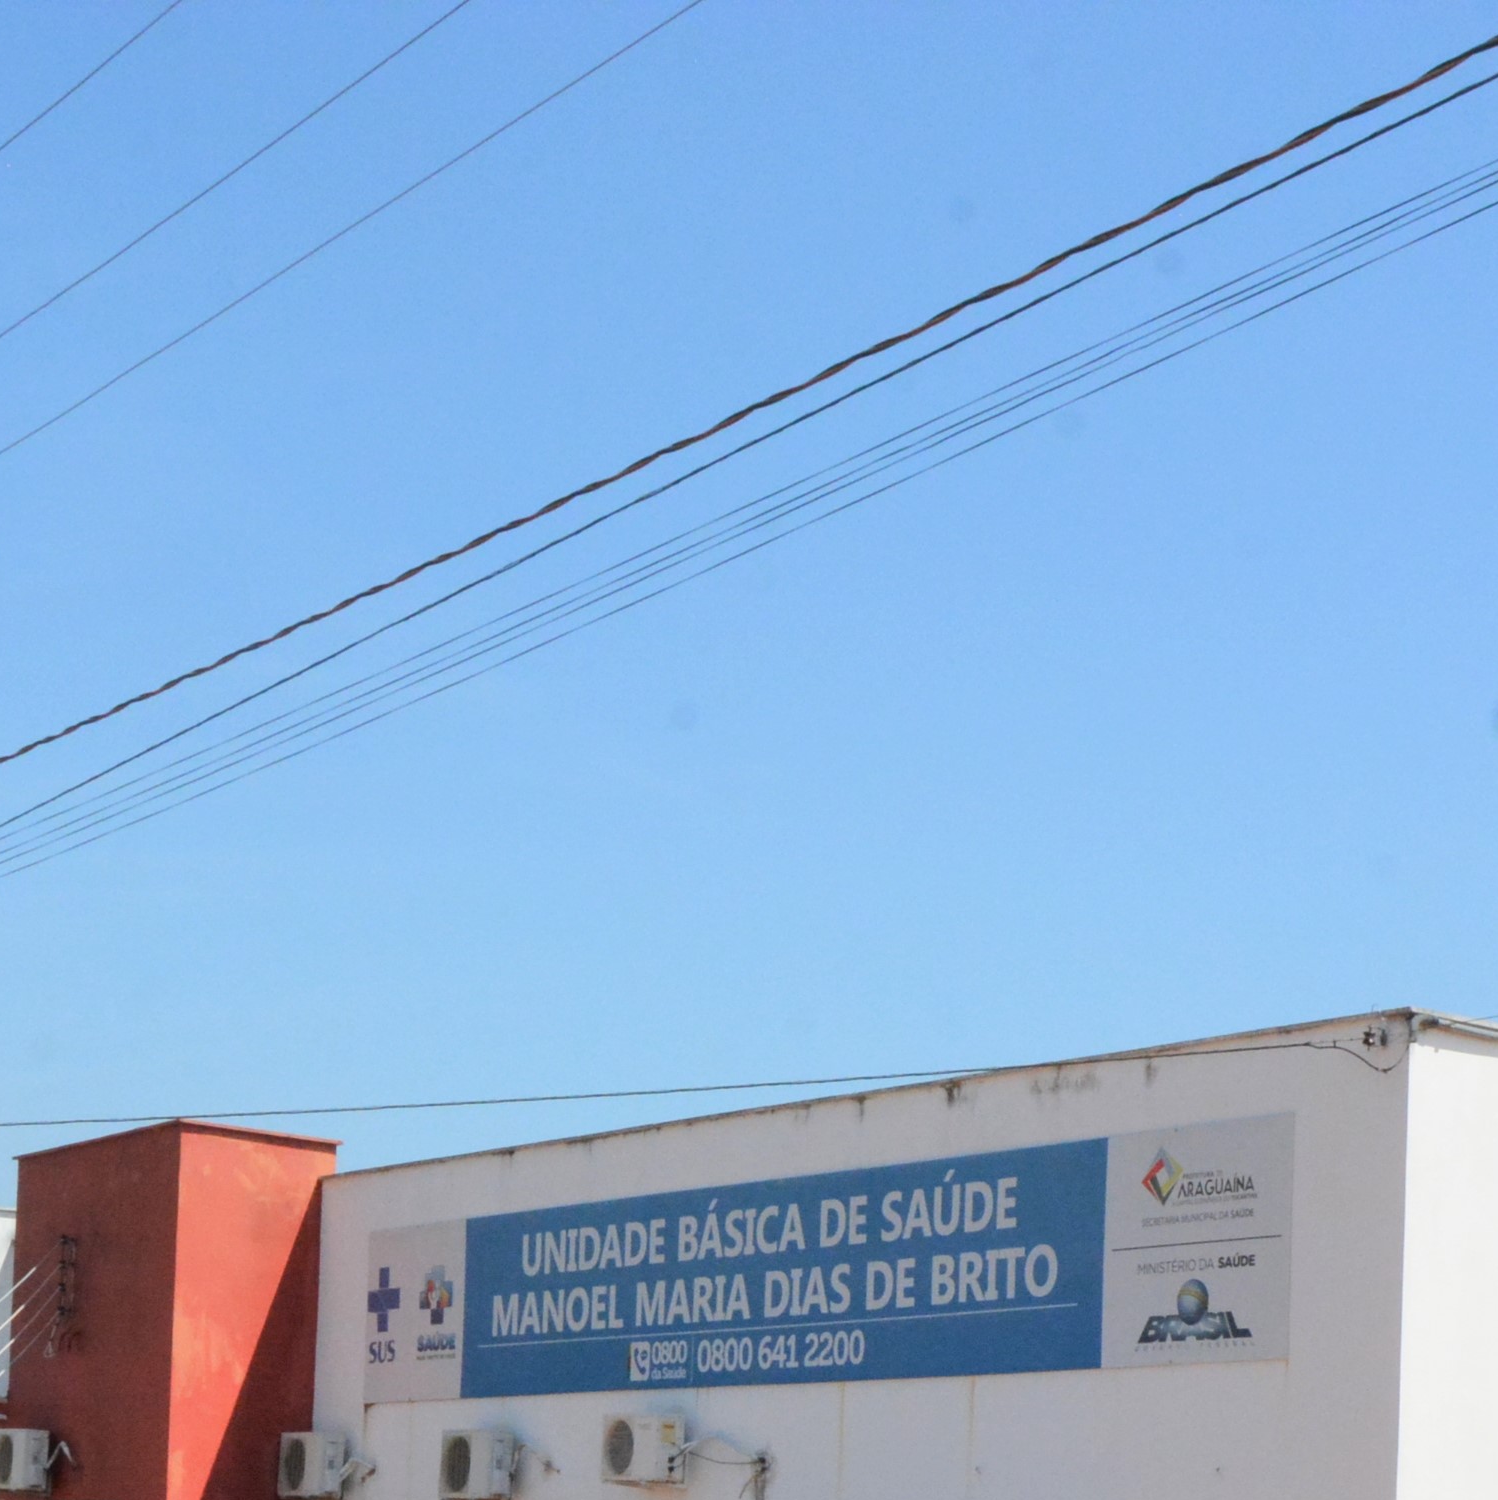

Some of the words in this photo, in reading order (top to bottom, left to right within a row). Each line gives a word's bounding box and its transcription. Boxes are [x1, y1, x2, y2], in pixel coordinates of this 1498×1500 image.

[1178, 1172, 1254, 1199] ARAGUAÍNA
[522, 1219, 666, 1277] UNIDADE
[678, 1198, 806, 1262] BÁSICA
[819, 1195, 868, 1248] DE
[881, 1169, 1018, 1242] SAÚDE
[1181, 1211, 1217, 1222] MUNICIPAL
[1137, 1258, 1196, 1275] MINISTÉRIO
[1199, 1258, 1215, 1270] DA
[1218, 1253, 1255, 1268] SAÚDE
[492, 1285, 624, 1337] MANOEL
[635, 1274, 751, 1327] MARIA
[764, 1263, 850, 1318] DIAS
[865, 1257, 915, 1310] DE
[931, 1243, 1058, 1306] BRITO
[1138, 1311, 1252, 1343] BRASIL
[369, 1339, 396, 1364] SUS
[652, 1340, 688, 1365] 0800
[697, 1336, 753, 1373] 0800
[758, 1334, 799, 1370] 641
[804, 1329, 865, 1367] 2200
[651, 1367, 662, 1379] da
